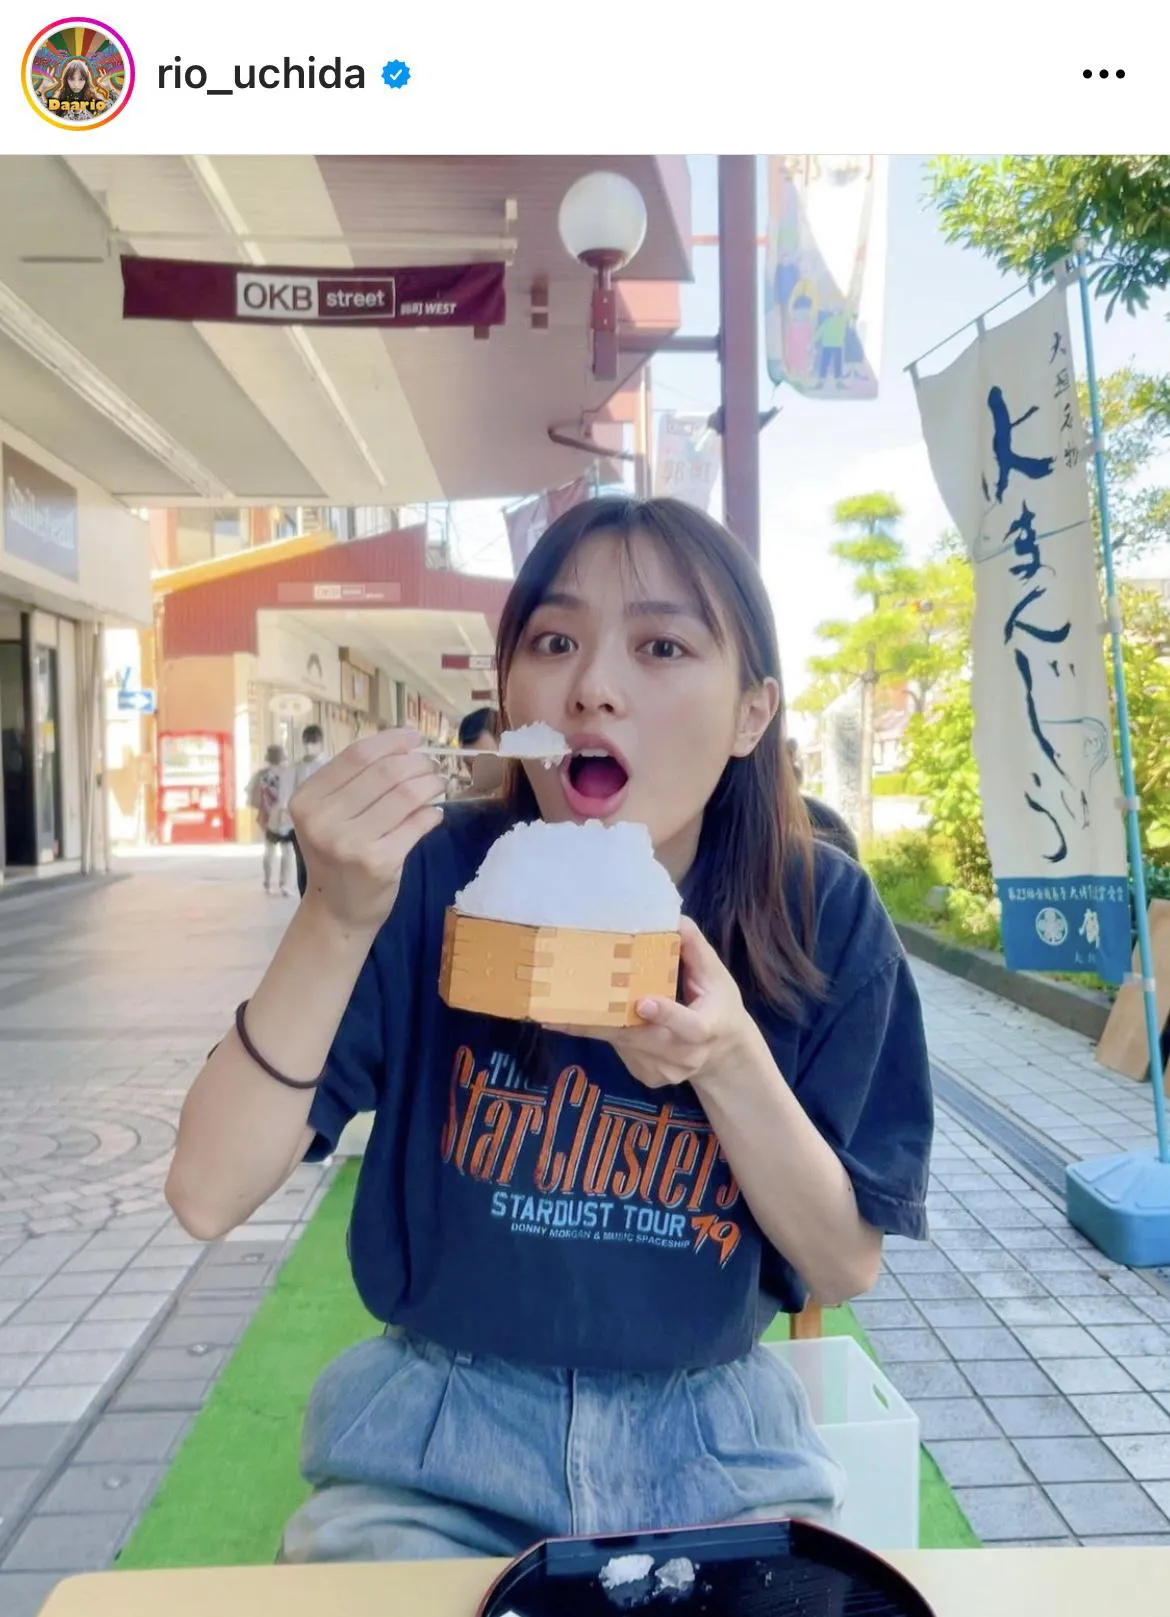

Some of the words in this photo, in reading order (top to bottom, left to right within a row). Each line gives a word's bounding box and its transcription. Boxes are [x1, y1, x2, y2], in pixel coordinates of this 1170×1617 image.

[243, 281, 313, 311] OKB
[326, 289, 385, 308] street
[425, 302, 457, 315] WEST
[491, 1191, 614, 1228] STARDUST
[623, 1204, 686, 1238] TOUR
[511, 1222, 548, 1237] DONNY
[549, 1229, 591, 1240] MORGAN
[593, 1231, 600, 1240] &
[637, 1234, 690, 1249] SPACESHIP
